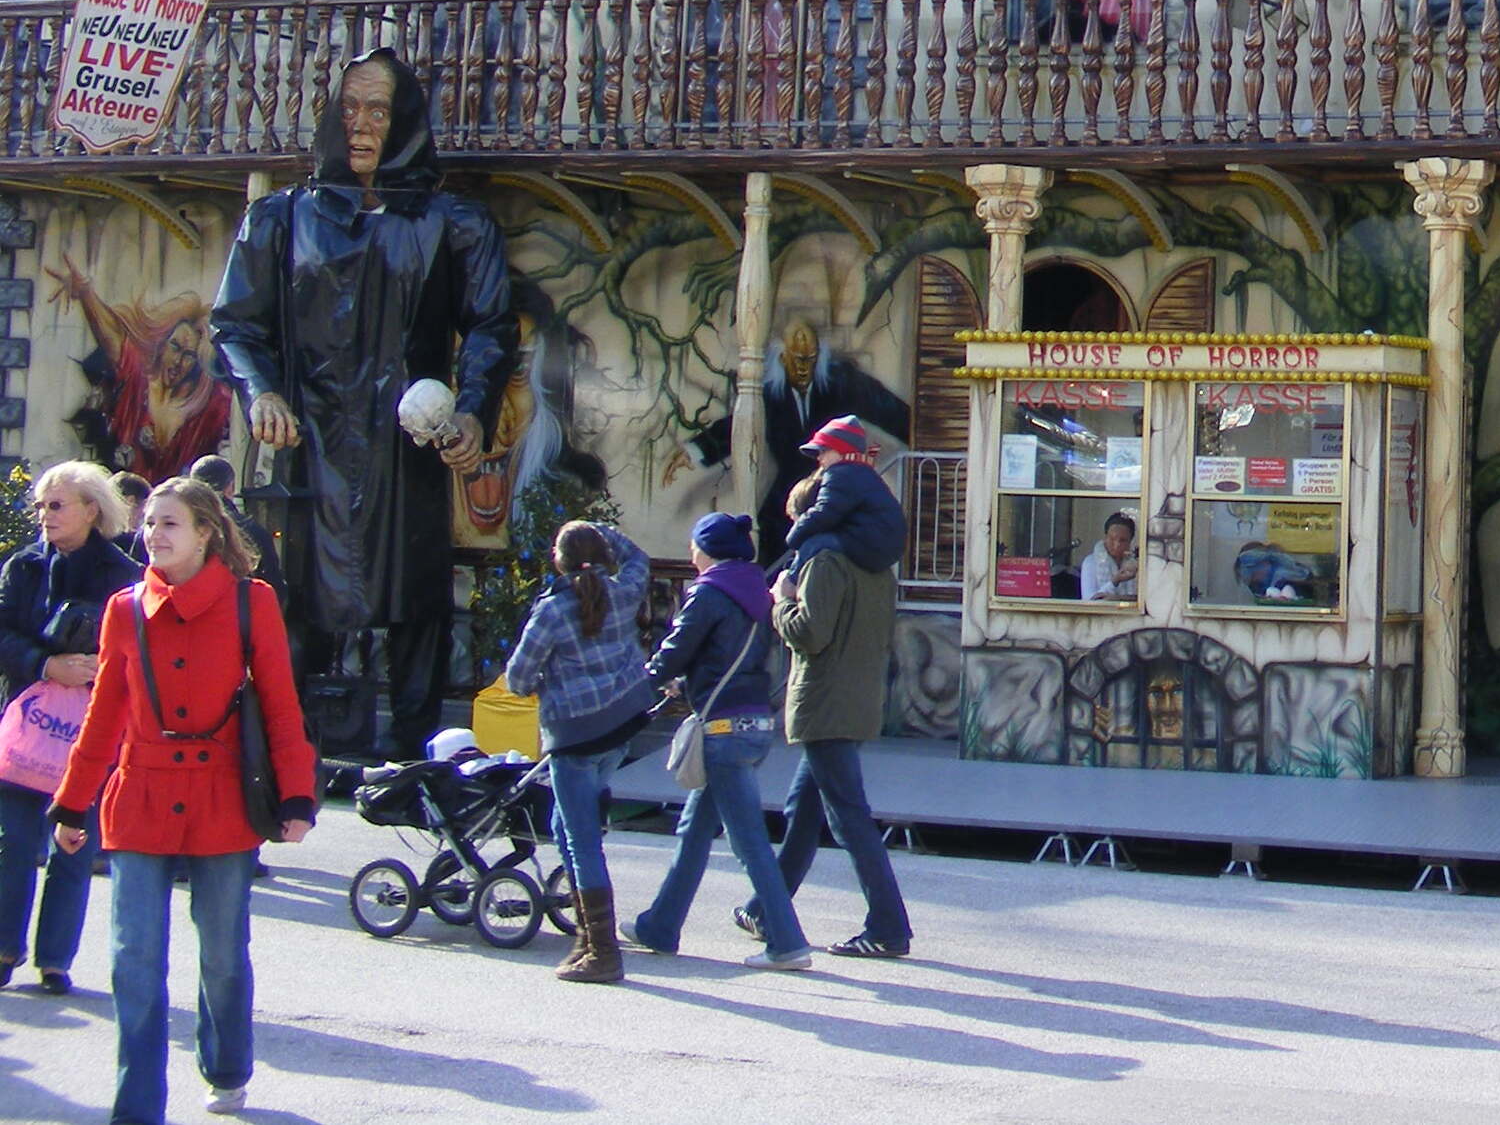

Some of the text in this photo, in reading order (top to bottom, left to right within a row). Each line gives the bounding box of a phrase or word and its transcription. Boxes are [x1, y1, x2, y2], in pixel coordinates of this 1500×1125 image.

[78, 37, 176, 77] LIVE-
[75, 65, 160, 99] Grusel-
[61, 88, 159, 124] Akteure
[1027, 341, 1320, 369] HOUSE OF HORROR
[1014, 380, 1128, 411] KASSE
[1206, 383, 1329, 415] KASSE
[1300, 485, 1336, 494] GRATIS!
